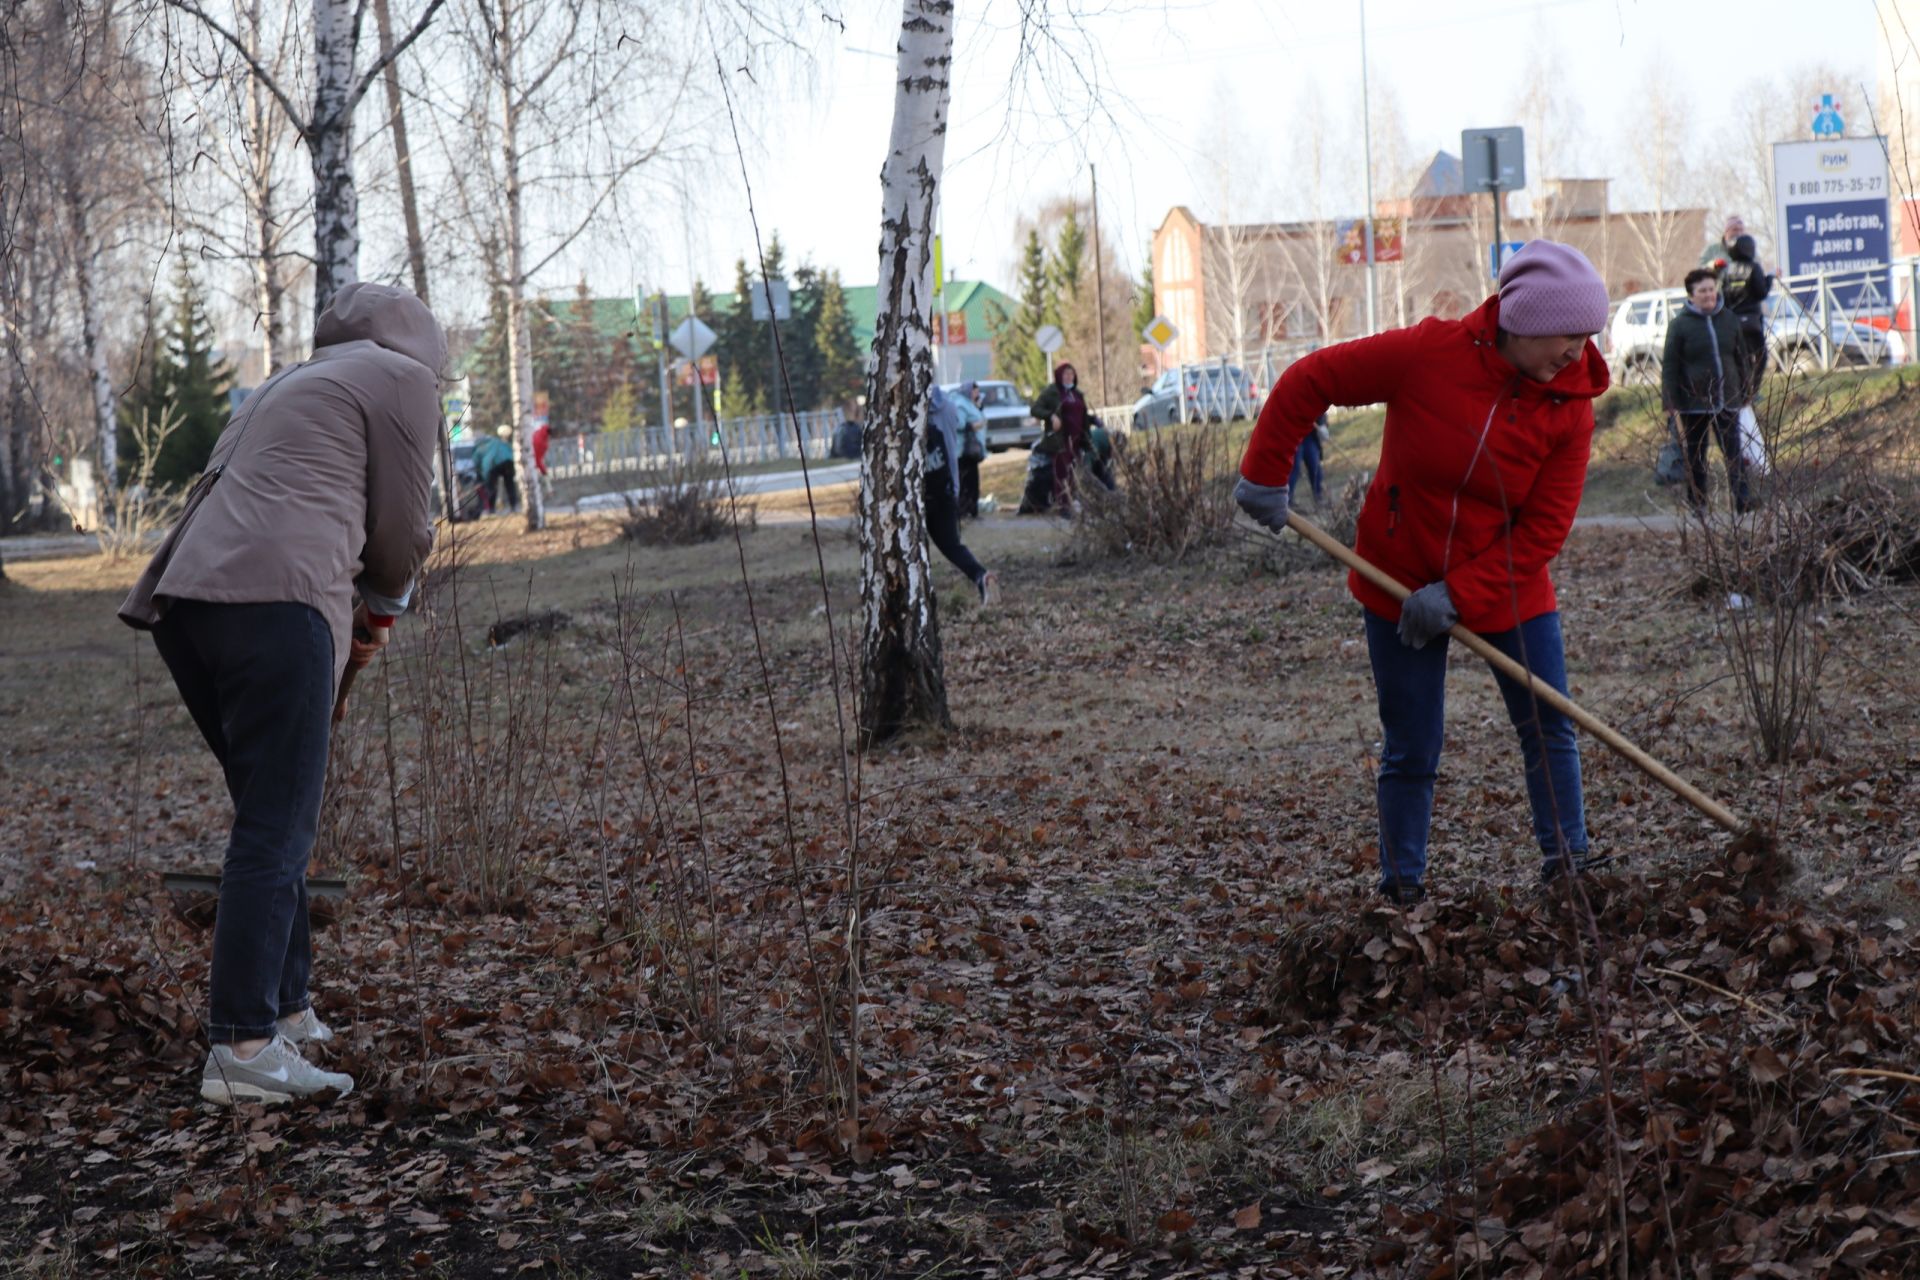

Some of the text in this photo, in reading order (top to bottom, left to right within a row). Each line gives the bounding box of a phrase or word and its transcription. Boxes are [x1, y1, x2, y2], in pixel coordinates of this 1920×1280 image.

[1822, 154, 1848, 166] РИМ
[1790, 176, 1882, 195] 8 800 775-35-27
[1806, 215, 1816, 233] Я
[1818, 213, 1884, 235] работаю,
[1813, 238, 1865, 256] даже в
